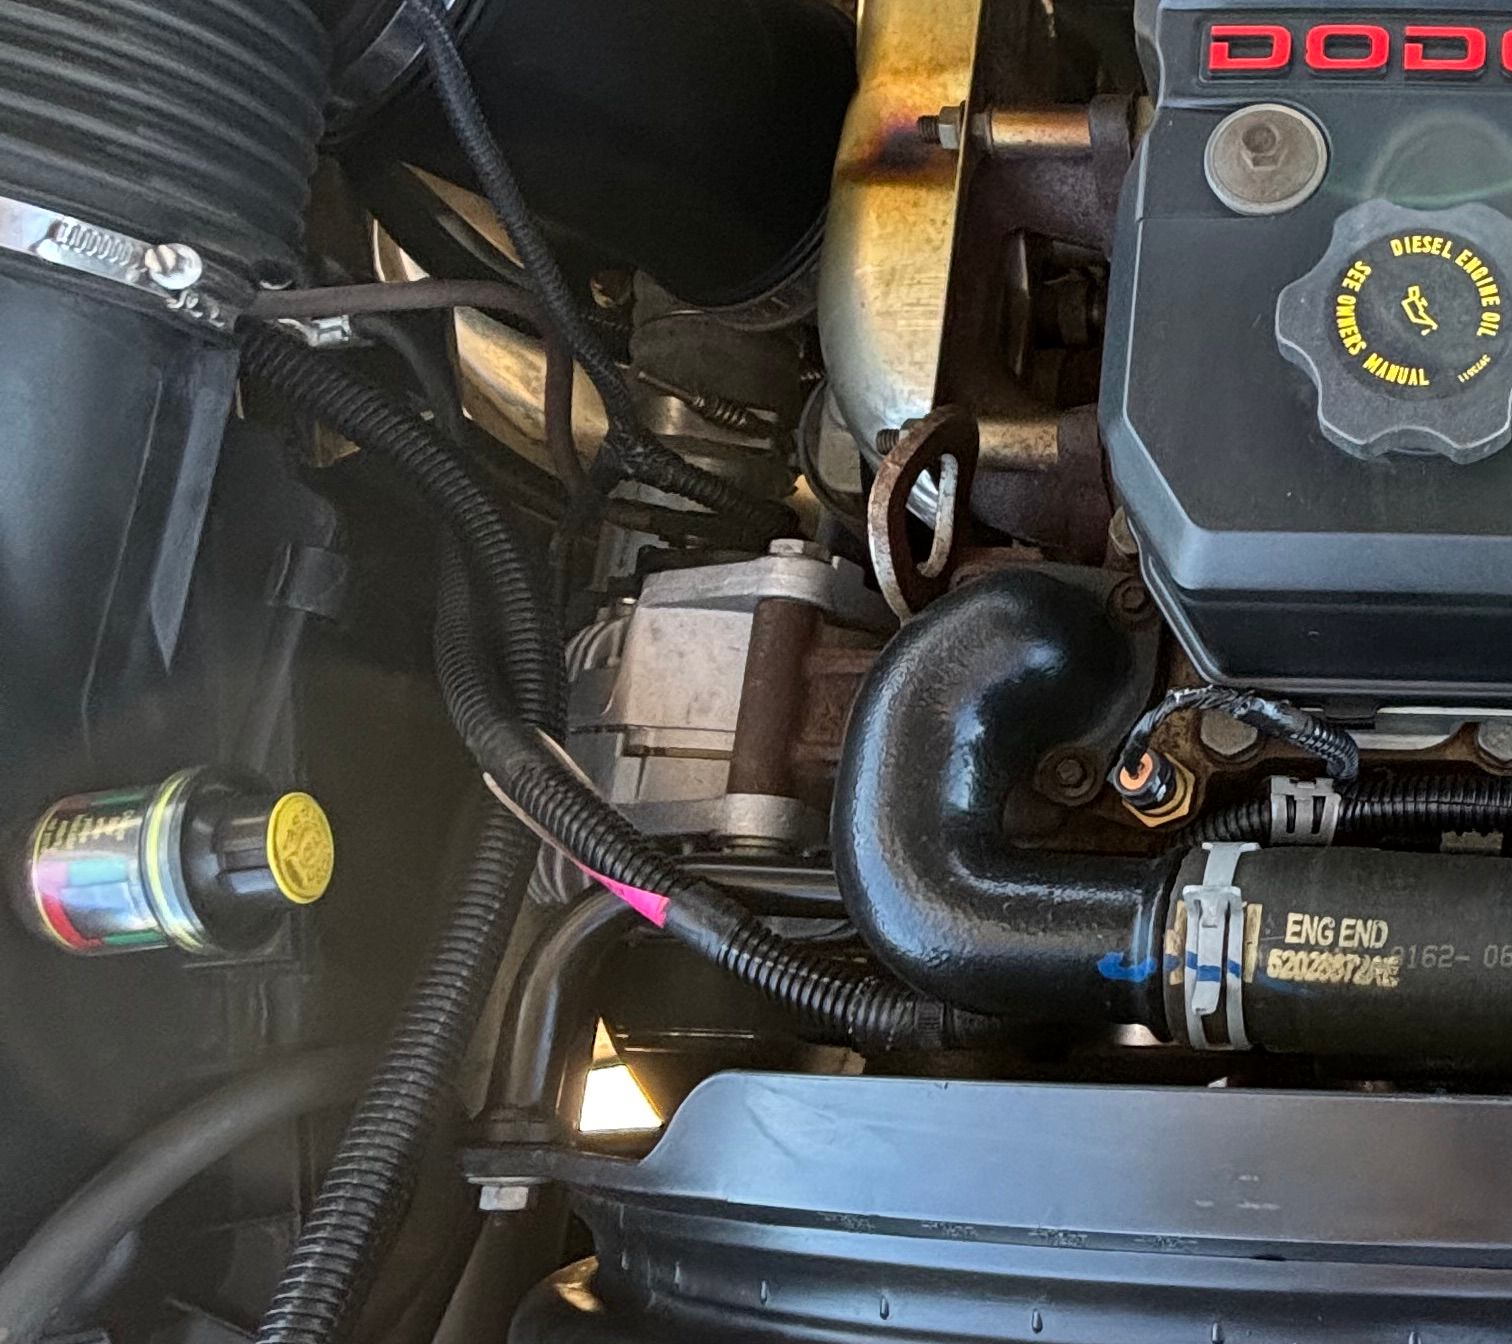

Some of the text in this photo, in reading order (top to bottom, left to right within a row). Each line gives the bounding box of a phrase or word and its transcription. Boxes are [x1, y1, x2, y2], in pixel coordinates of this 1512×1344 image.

[1336, 260, 1430, 386] SEE OWNERS MANUAL
[1390, 235, 1501, 337] DIESEL ENGINE OIL
[1285, 912, 1389, 949] ENG END
